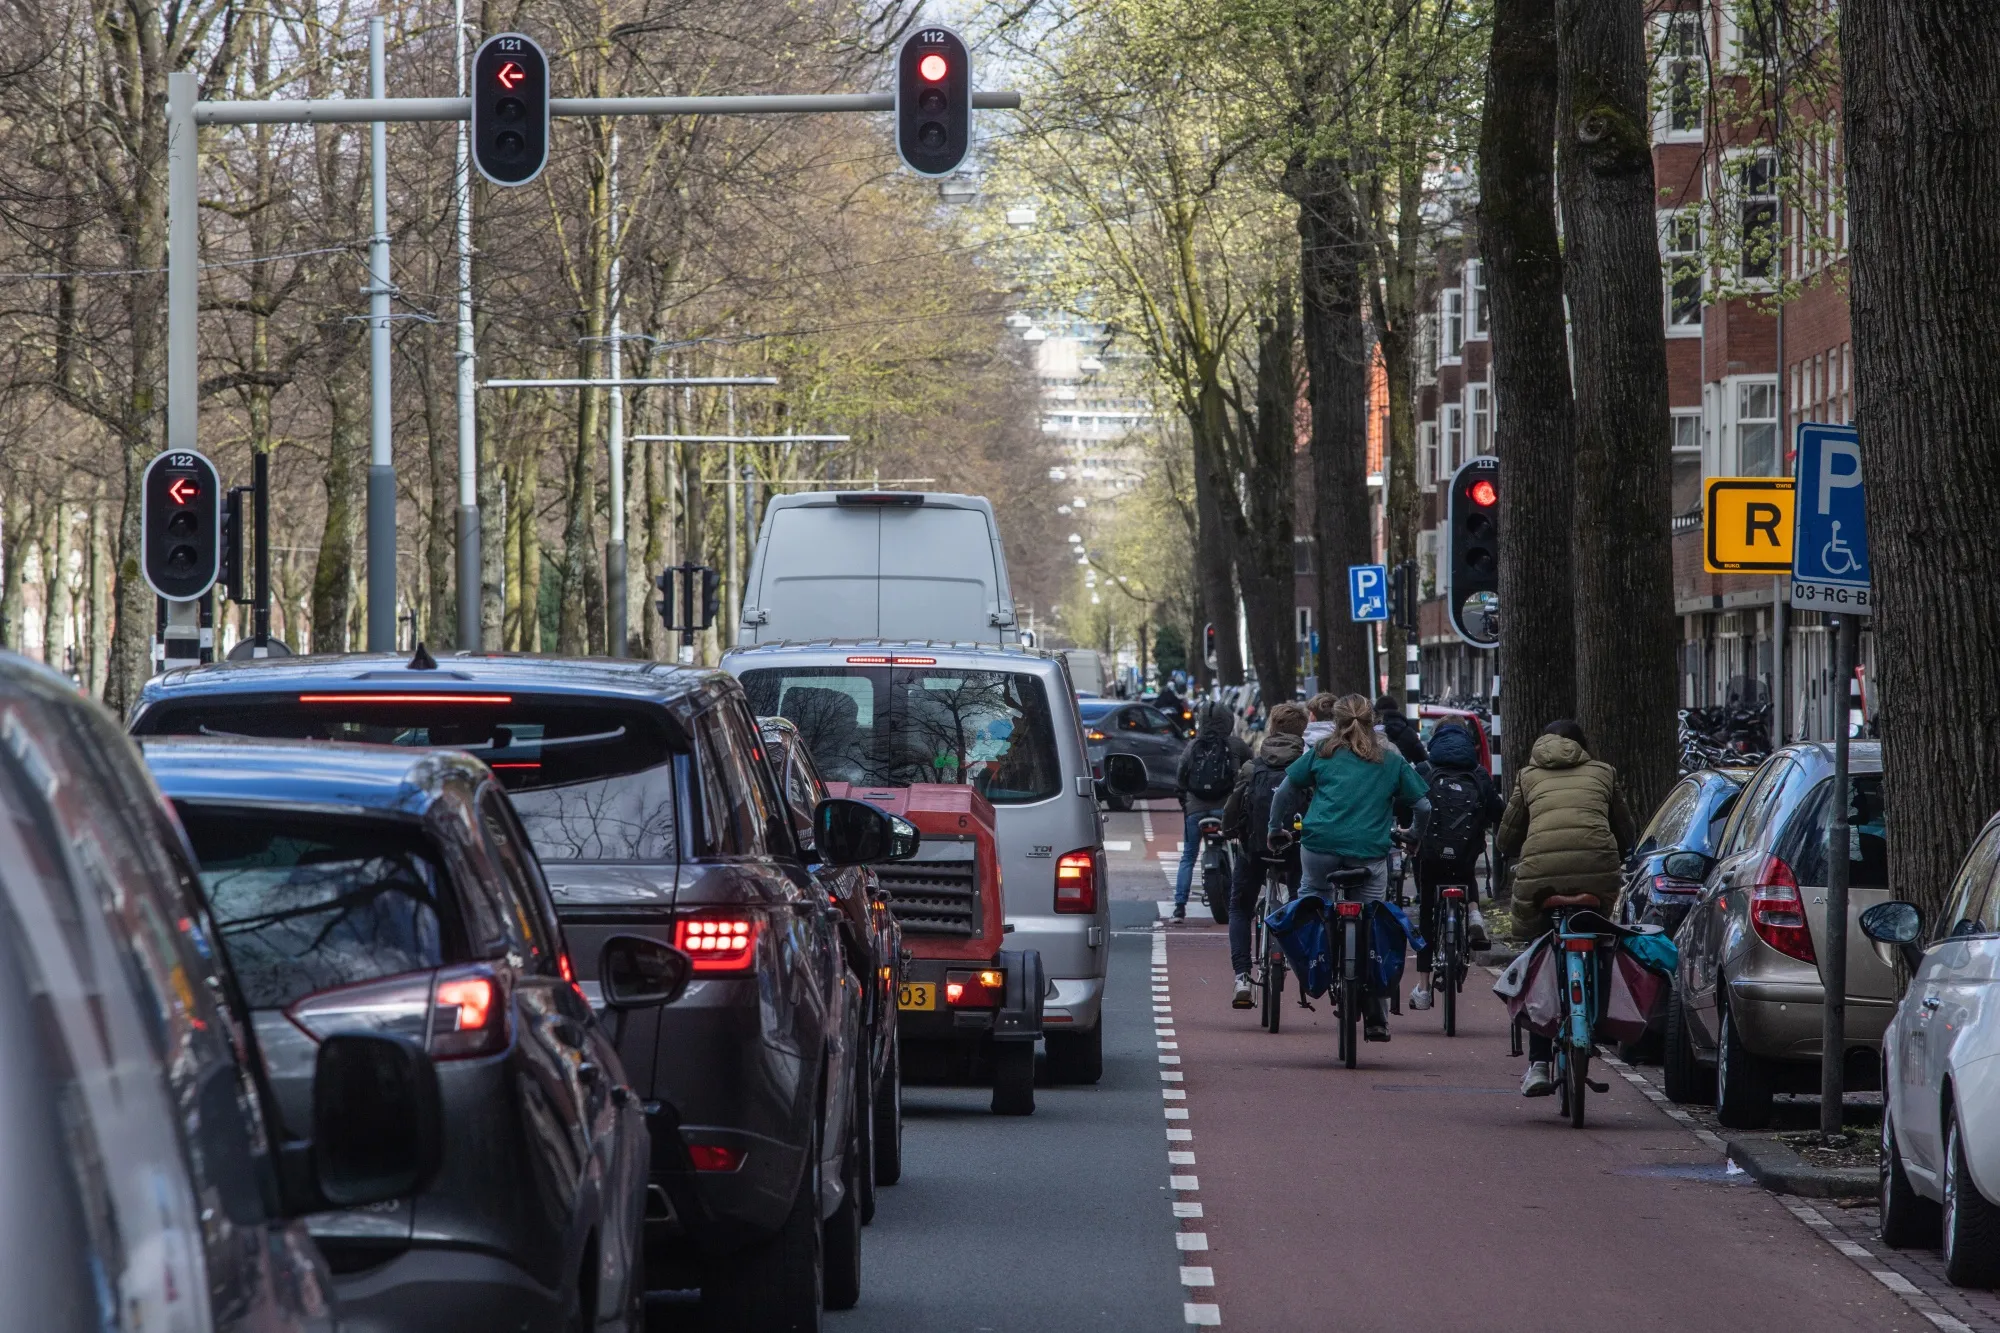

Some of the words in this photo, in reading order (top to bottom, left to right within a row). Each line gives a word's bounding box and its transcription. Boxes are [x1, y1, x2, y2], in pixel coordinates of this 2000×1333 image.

[921, 31, 945, 43] 112
[498, 39, 522, 50] 121
[169, 455, 194, 467] 122
[1477, 460, 1495, 469] 111
[1818, 439, 1863, 515] P
[1745, 502, 1782, 547] R
[1357, 570, 1378, 598] P
[1795, 584, 1872, 606] 03-RG-B
[958, 815, 968, 828] 6
